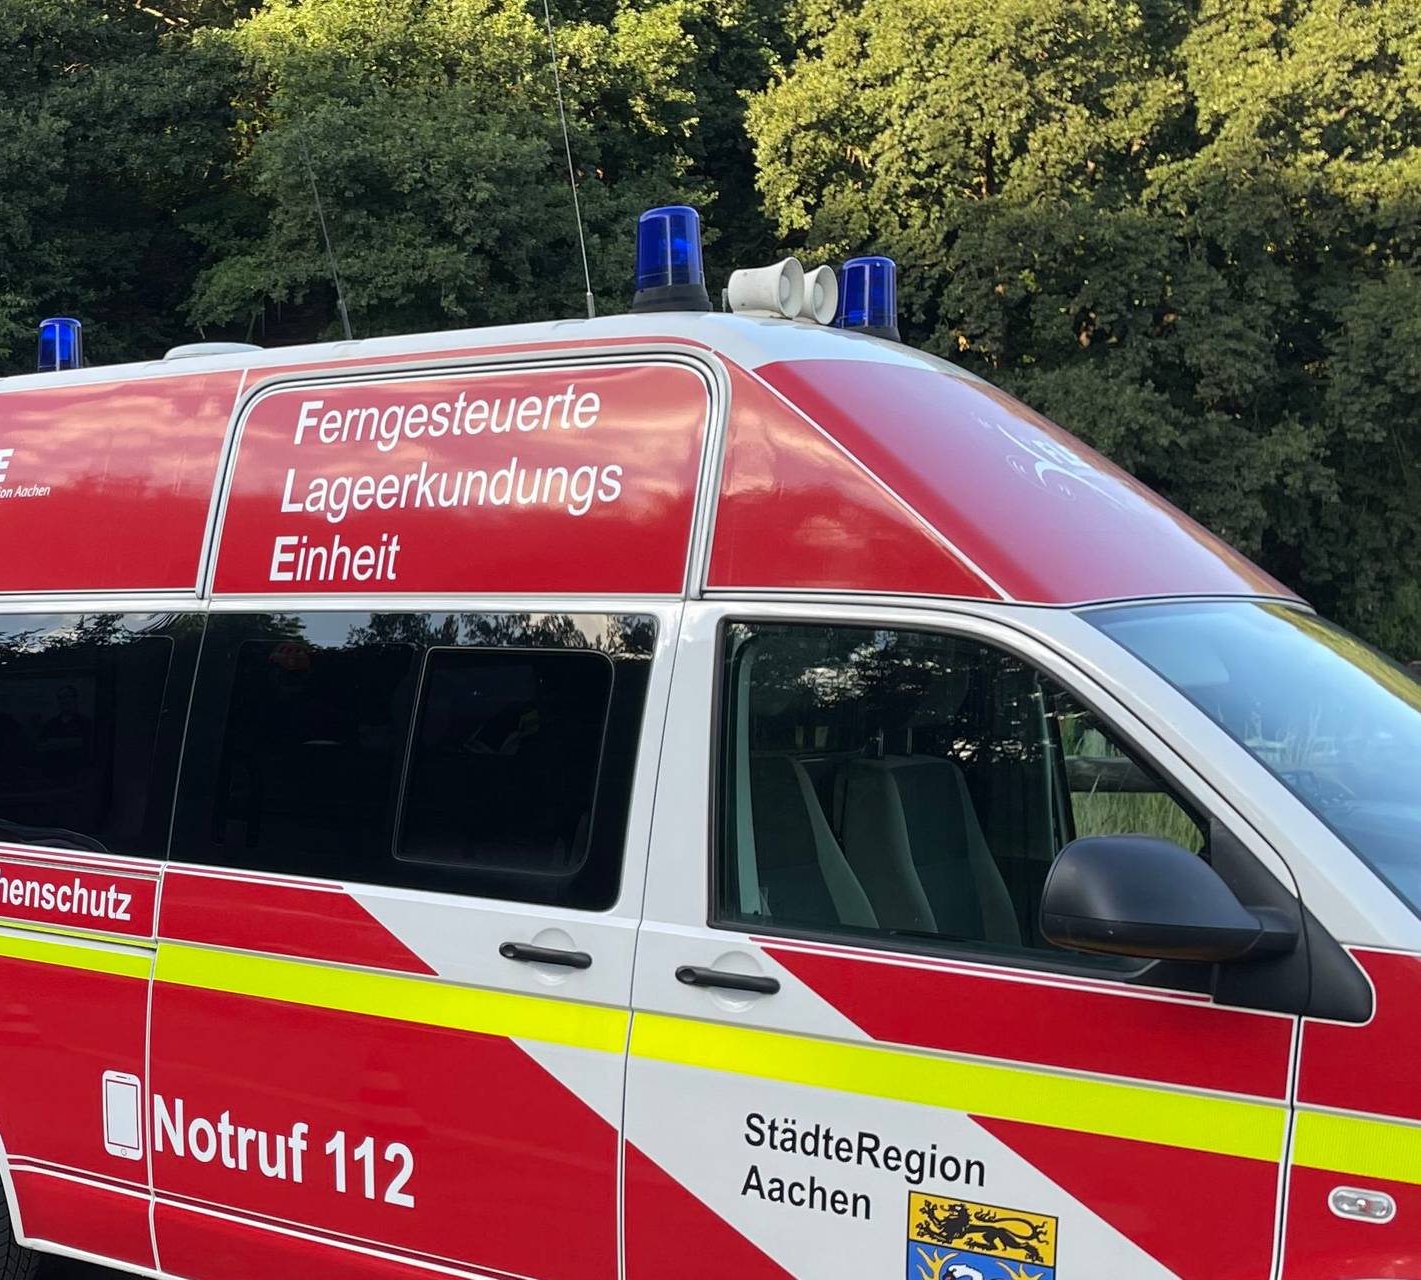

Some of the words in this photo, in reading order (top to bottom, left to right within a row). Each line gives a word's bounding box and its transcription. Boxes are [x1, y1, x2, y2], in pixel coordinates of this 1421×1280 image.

[293, 383, 601, 452] Ferngesteuerte
[15, 484, 51, 498] Aachen
[280, 456, 624, 524] Lageerkundungs
[268, 532, 401, 582] Einheit
[153, 1093, 309, 1184] Notruf
[325, 1130, 416, 1209] 112
[743, 1112, 986, 1188] StädteRegion
[740, 1164, 871, 1220] Aachen
